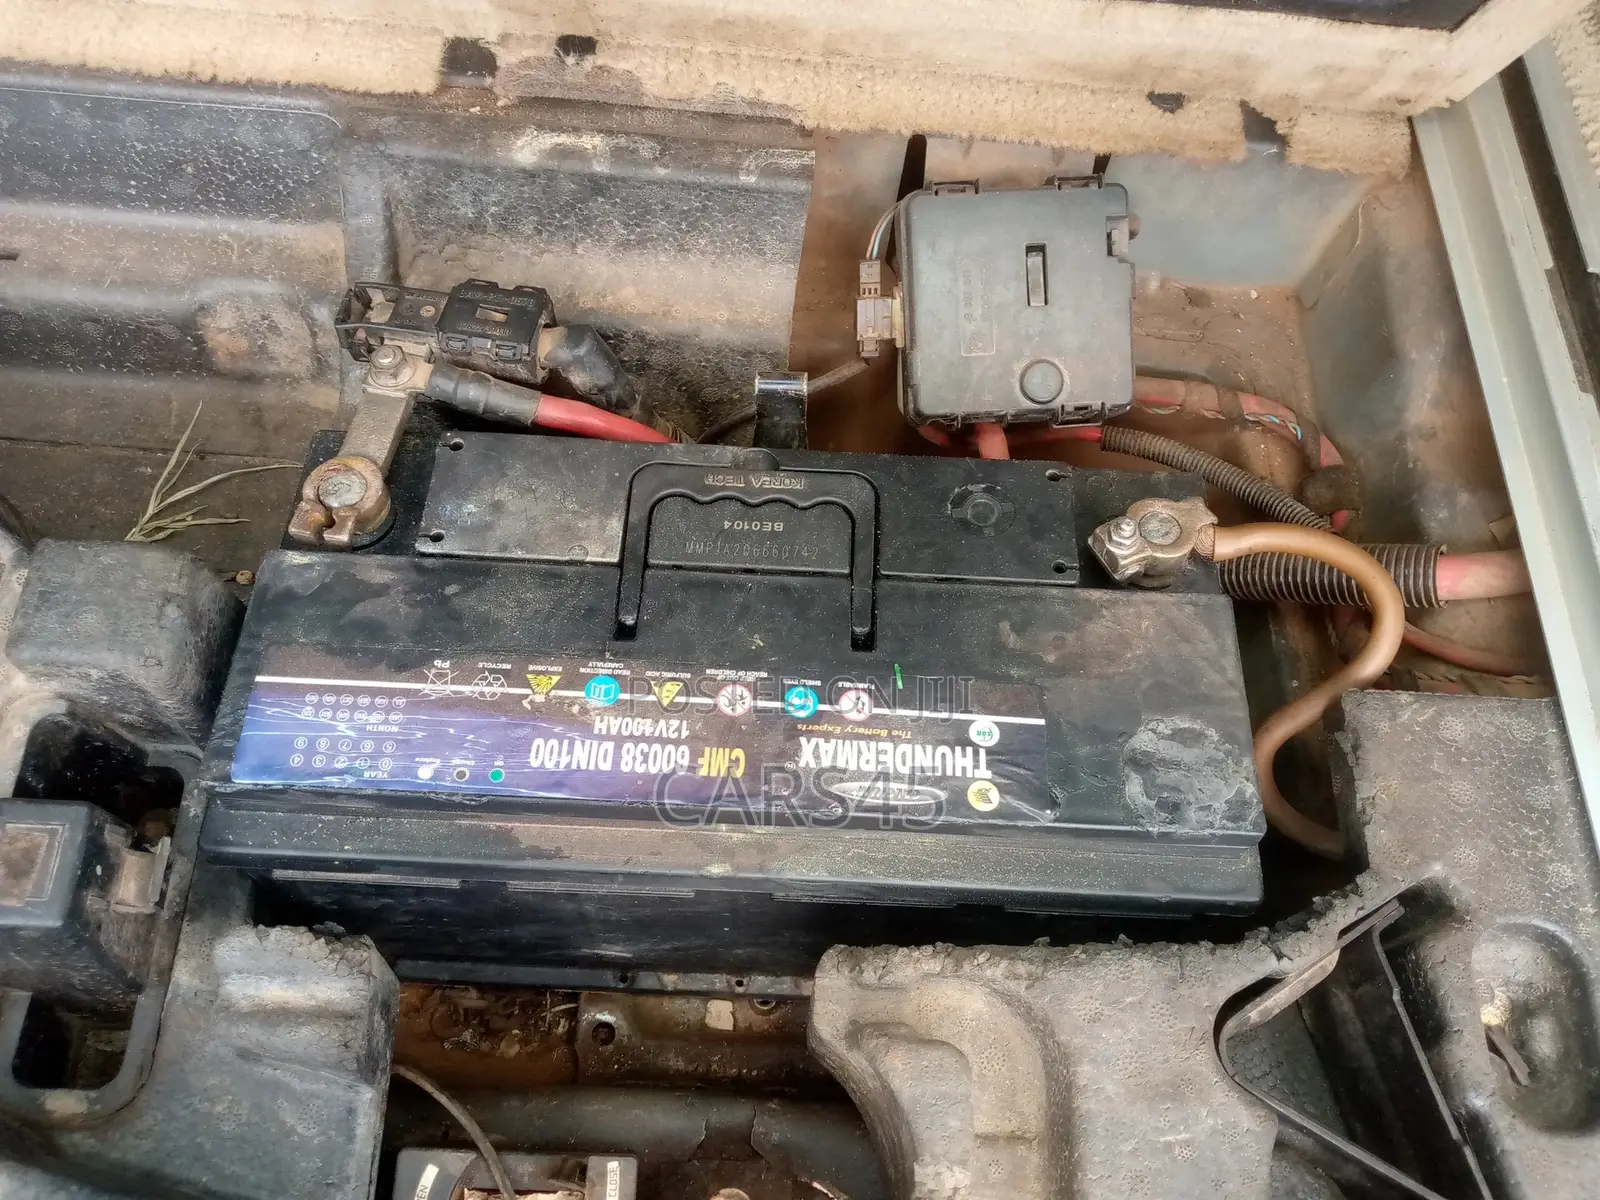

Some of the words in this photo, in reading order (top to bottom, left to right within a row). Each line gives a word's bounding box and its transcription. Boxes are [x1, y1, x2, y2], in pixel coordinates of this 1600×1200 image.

[704, 473, 746, 487] TECH
[751, 474, 804, 489] KOREA
[723, 520, 784, 532] BE0104
[433, 660, 451, 668] Pb
[477, 662, 512, 670] RECYCLE
[528, 664, 563, 672] EXPLOSIVE
[588, 661, 624, 669] CAREFULLY
[579, 667, 615, 675] DIRECTION
[705, 668, 736, 676] CHILDREN
[366, 724, 399, 732] MONTH
[796, 723, 841, 734] Experts
[844, 726, 888, 736] Battery
[891, 729, 912, 739] The
[529, 737, 615, 772] DIN100
[620, 742, 690, 775] 60038
[798, 737, 993, 779] THUNDERMAX
[697, 746, 746, 778] CMF
[363, 770, 388, 778] YEAR
[609, 1166, 618, 1197] CLOSE
